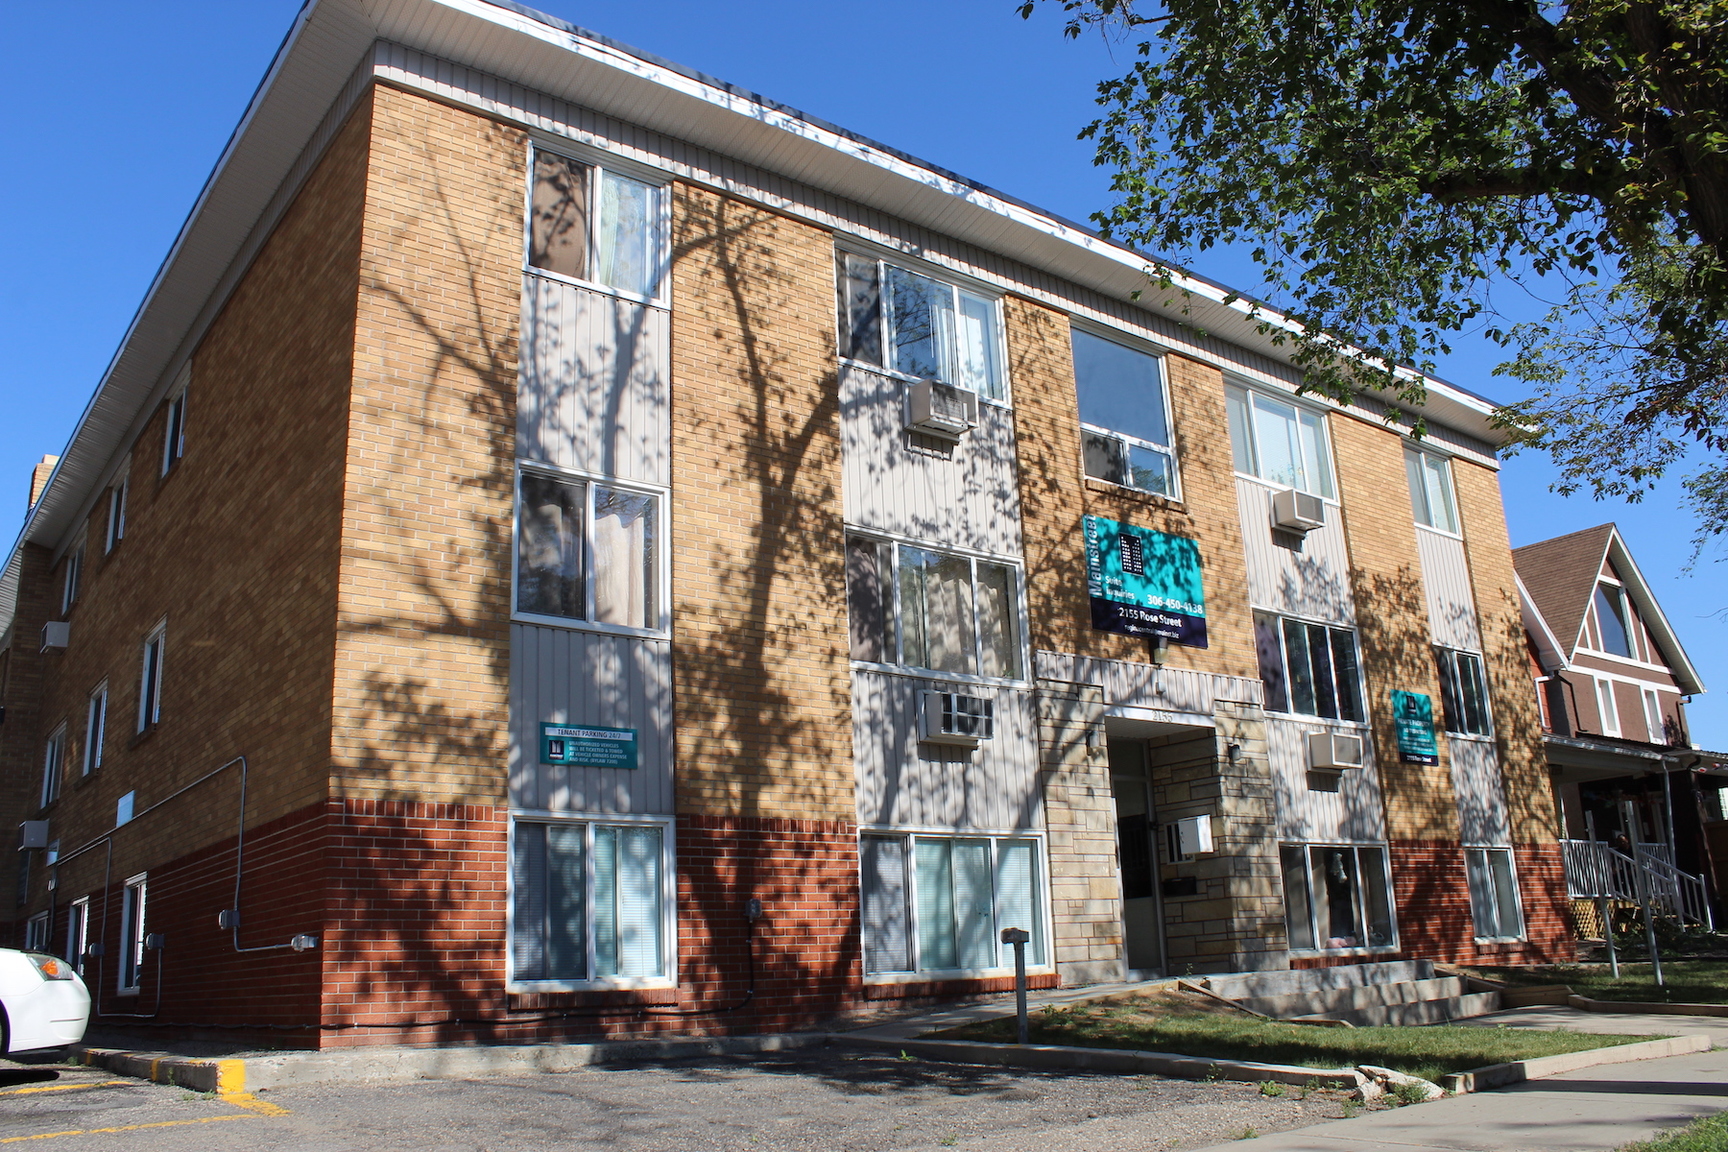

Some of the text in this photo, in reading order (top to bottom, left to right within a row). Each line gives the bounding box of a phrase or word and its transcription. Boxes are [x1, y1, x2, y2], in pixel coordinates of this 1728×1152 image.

[1085, 513, 1102, 596] Mainstreet
[1147, 594, 1203, 614] 306-450-4138
[1119, 607, 1182, 627] 2155 Rose Street
[1152, 710, 1172, 723] 2155
